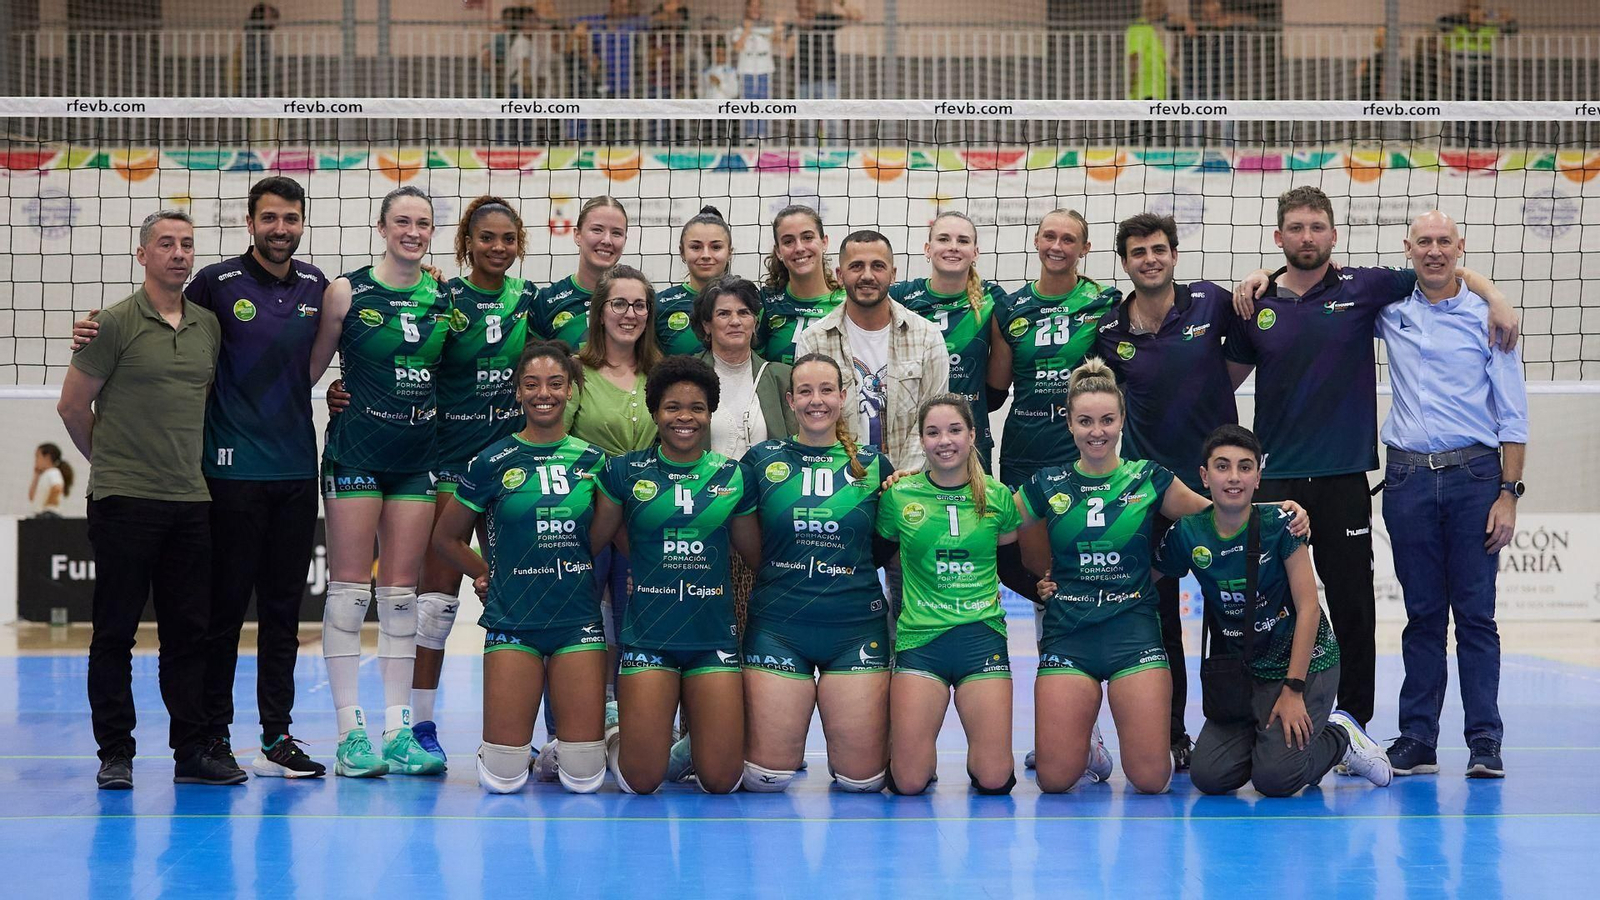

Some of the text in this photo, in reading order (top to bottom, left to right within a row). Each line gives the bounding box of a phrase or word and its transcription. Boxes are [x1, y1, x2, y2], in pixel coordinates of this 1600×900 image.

[67, 101, 145, 113] rfevb.com
[284, 101, 362, 114] rfevb.com
[502, 101, 579, 114] rfevb.com
[719, 102, 796, 114] rfevb.com
[935, 102, 1012, 115] rfevb.com
[1150, 103, 1227, 115] rfevb.com
[1364, 103, 1440, 116] rfevb.com
[400, 312, 421, 343] 6
[485, 315, 503, 344] 8
[1034, 315, 1070, 347] 23
[395, 368, 432, 382] PRO
[477, 368, 513, 383] PRO
[1035, 367, 1071, 381] PRO
[366, 406, 408, 420] Fundación
[1014, 408, 1049, 417] Fundación
[217, 448, 234, 466] RT
[337, 476, 376, 485] MAX
[536, 464, 570, 495] 15
[801, 466, 834, 497] 10
[674, 484, 695, 515] 4
[536, 507, 573, 520] FP
[793, 507, 833, 520] FP
[1086, 497, 1105, 527] 2
[537, 520, 576, 534] PRO
[793, 520, 839, 534] PRO
[946, 504, 960, 537] 1
[663, 527, 699, 540] FP
[795, 533, 841, 542] FORMACIÓN
[664, 541, 704, 555] PRO
[796, 540, 846, 550] PROFESIONAL
[663, 554, 707, 562] FORMACIÓN
[935, 549, 970, 562] FP
[1080, 551, 1120, 566] PRO
[513, 566, 555, 576] Fundación
[663, 562, 712, 570] PROFESIONAL
[817, 562, 857, 576] Cajasol
[936, 561, 975, 575] PRO
[1080, 565, 1124, 574] FORMACIÓN
[1080, 573, 1131, 582] PROFESIONAL
[637, 584, 724, 599] Fundación Cajasol
[1253, 606, 1290, 633] Cajasol
[486, 632, 523, 645] MAX
[623, 652, 663, 665] MAX
[746, 654, 796, 667] MAX
